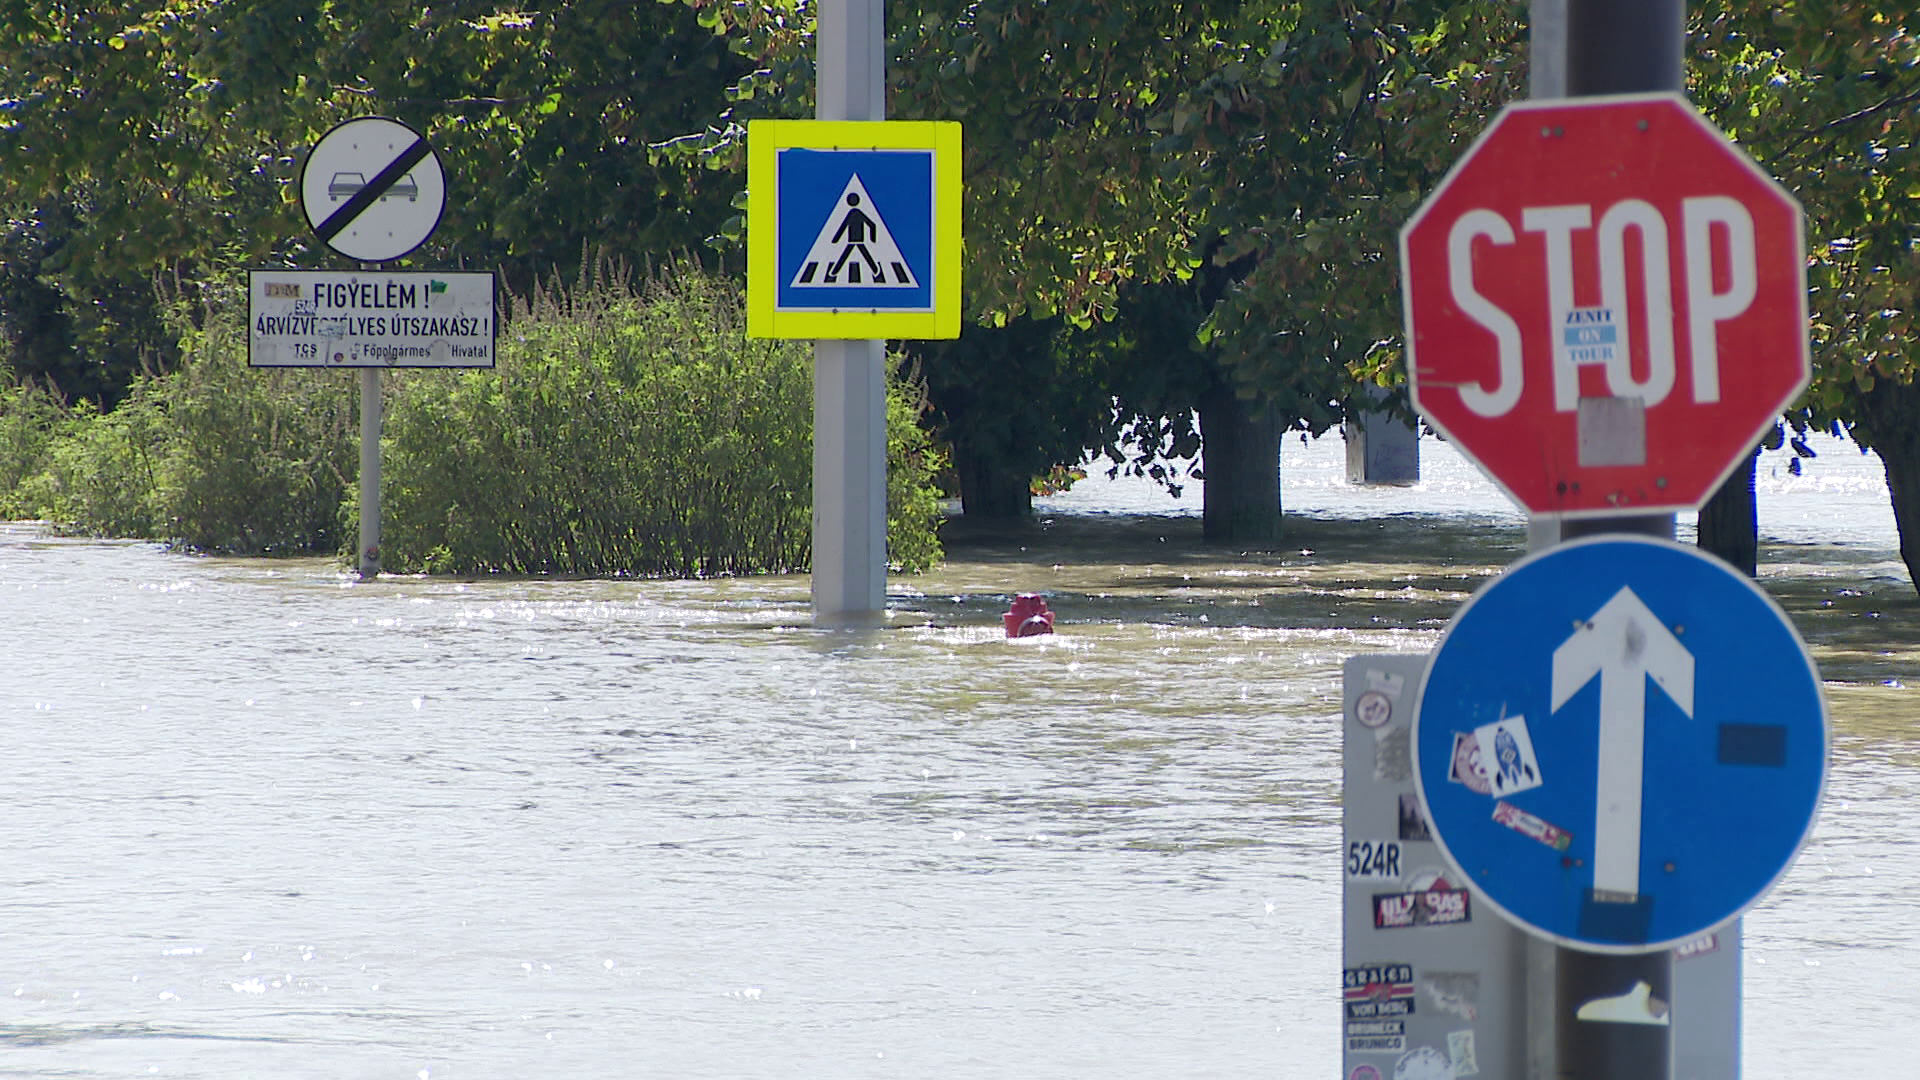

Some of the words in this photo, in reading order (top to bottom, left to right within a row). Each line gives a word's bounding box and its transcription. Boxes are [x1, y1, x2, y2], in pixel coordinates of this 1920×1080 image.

[314, 283, 415, 308] FIGYELEM
[1448, 195, 1758, 418] STOP
[1567, 310, 1613, 324] ZENIT
[1578, 328, 1601, 342] ON
[451, 344, 488, 358] Hivatal
[1567, 347, 1614, 361] TOUR
[1348, 842, 1400, 876] 524R
[1349, 1037, 1402, 1050] BRUNICO
